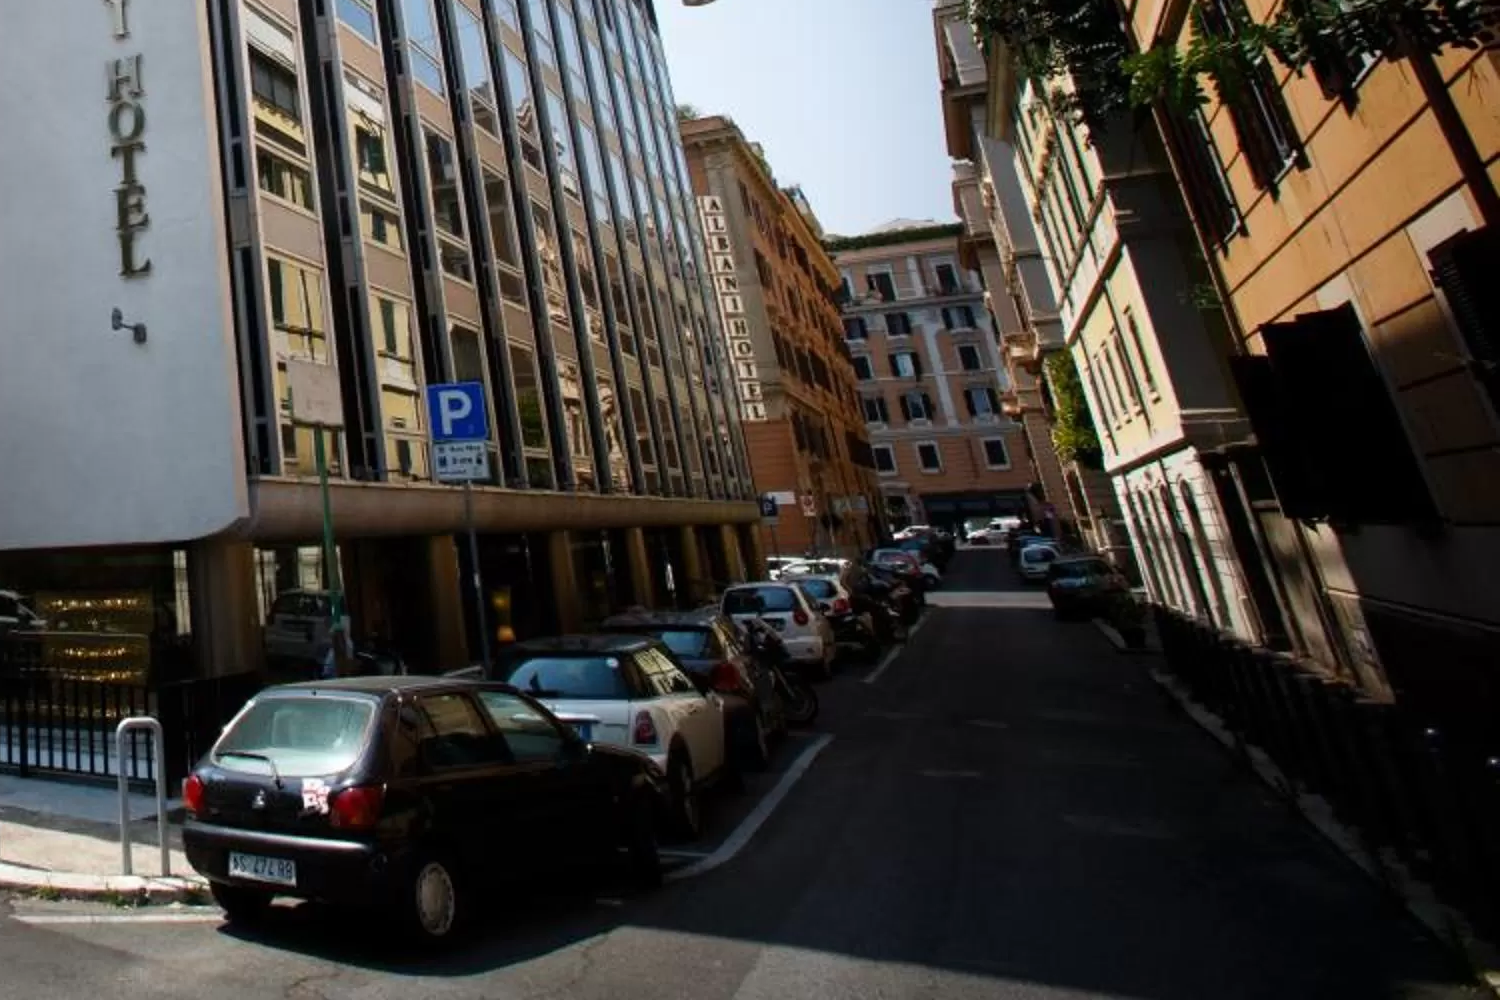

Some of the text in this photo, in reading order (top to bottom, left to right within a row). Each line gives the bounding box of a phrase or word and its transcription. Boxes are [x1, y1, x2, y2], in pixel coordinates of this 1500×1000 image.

[105, 52, 152, 278] HOTEL
[438, 391, 472, 435] P
[709, 199, 765, 419] ALBANI HOTEL
